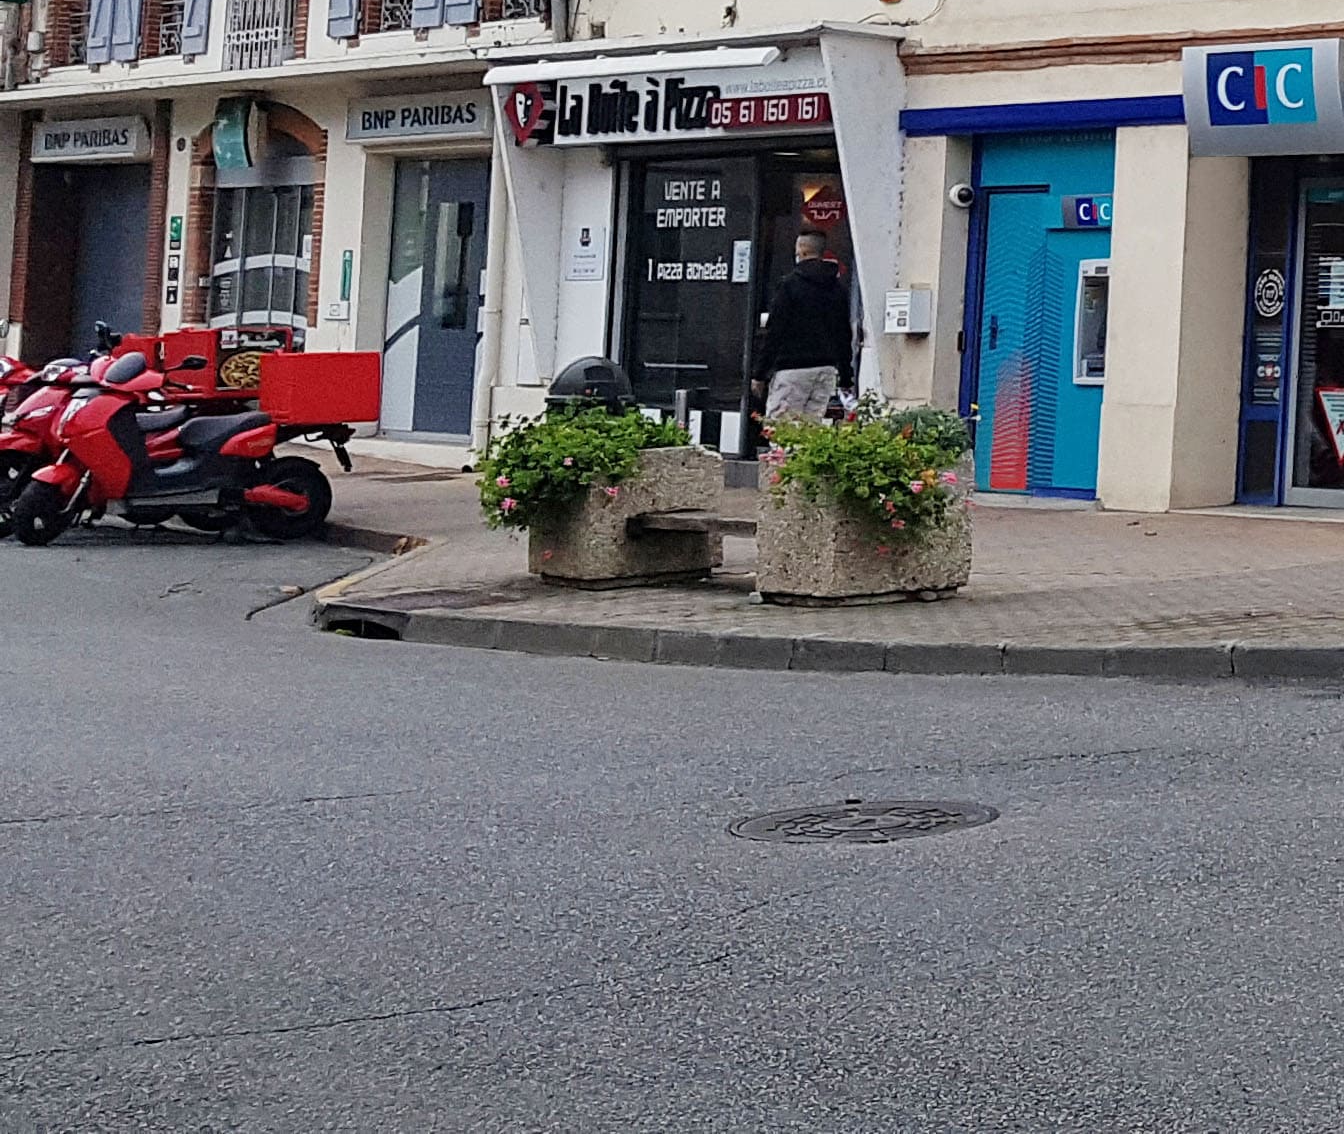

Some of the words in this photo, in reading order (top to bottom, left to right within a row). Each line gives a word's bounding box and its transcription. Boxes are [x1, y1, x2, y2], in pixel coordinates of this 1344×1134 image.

[1216, 63, 1305, 112] CIC
[361, 109, 396, 130] BNP
[400, 102, 477, 127] PARIBAS
[557, 84, 583, 136] La
[643, 76, 660, 133] à
[711, 102, 732, 125] 05
[739, 100, 755, 123] 61
[797, 96, 819, 120] 161
[73, 128, 129, 148] PARIBAS
[664, 180, 706, 200] VENTE
[711, 179, 721, 200] A
[656, 207, 727, 228] EMPORTER
[1079, 202, 1111, 221] CIC
[656, 262, 683, 281] pizza
[686, 255, 728, 281] achetée
